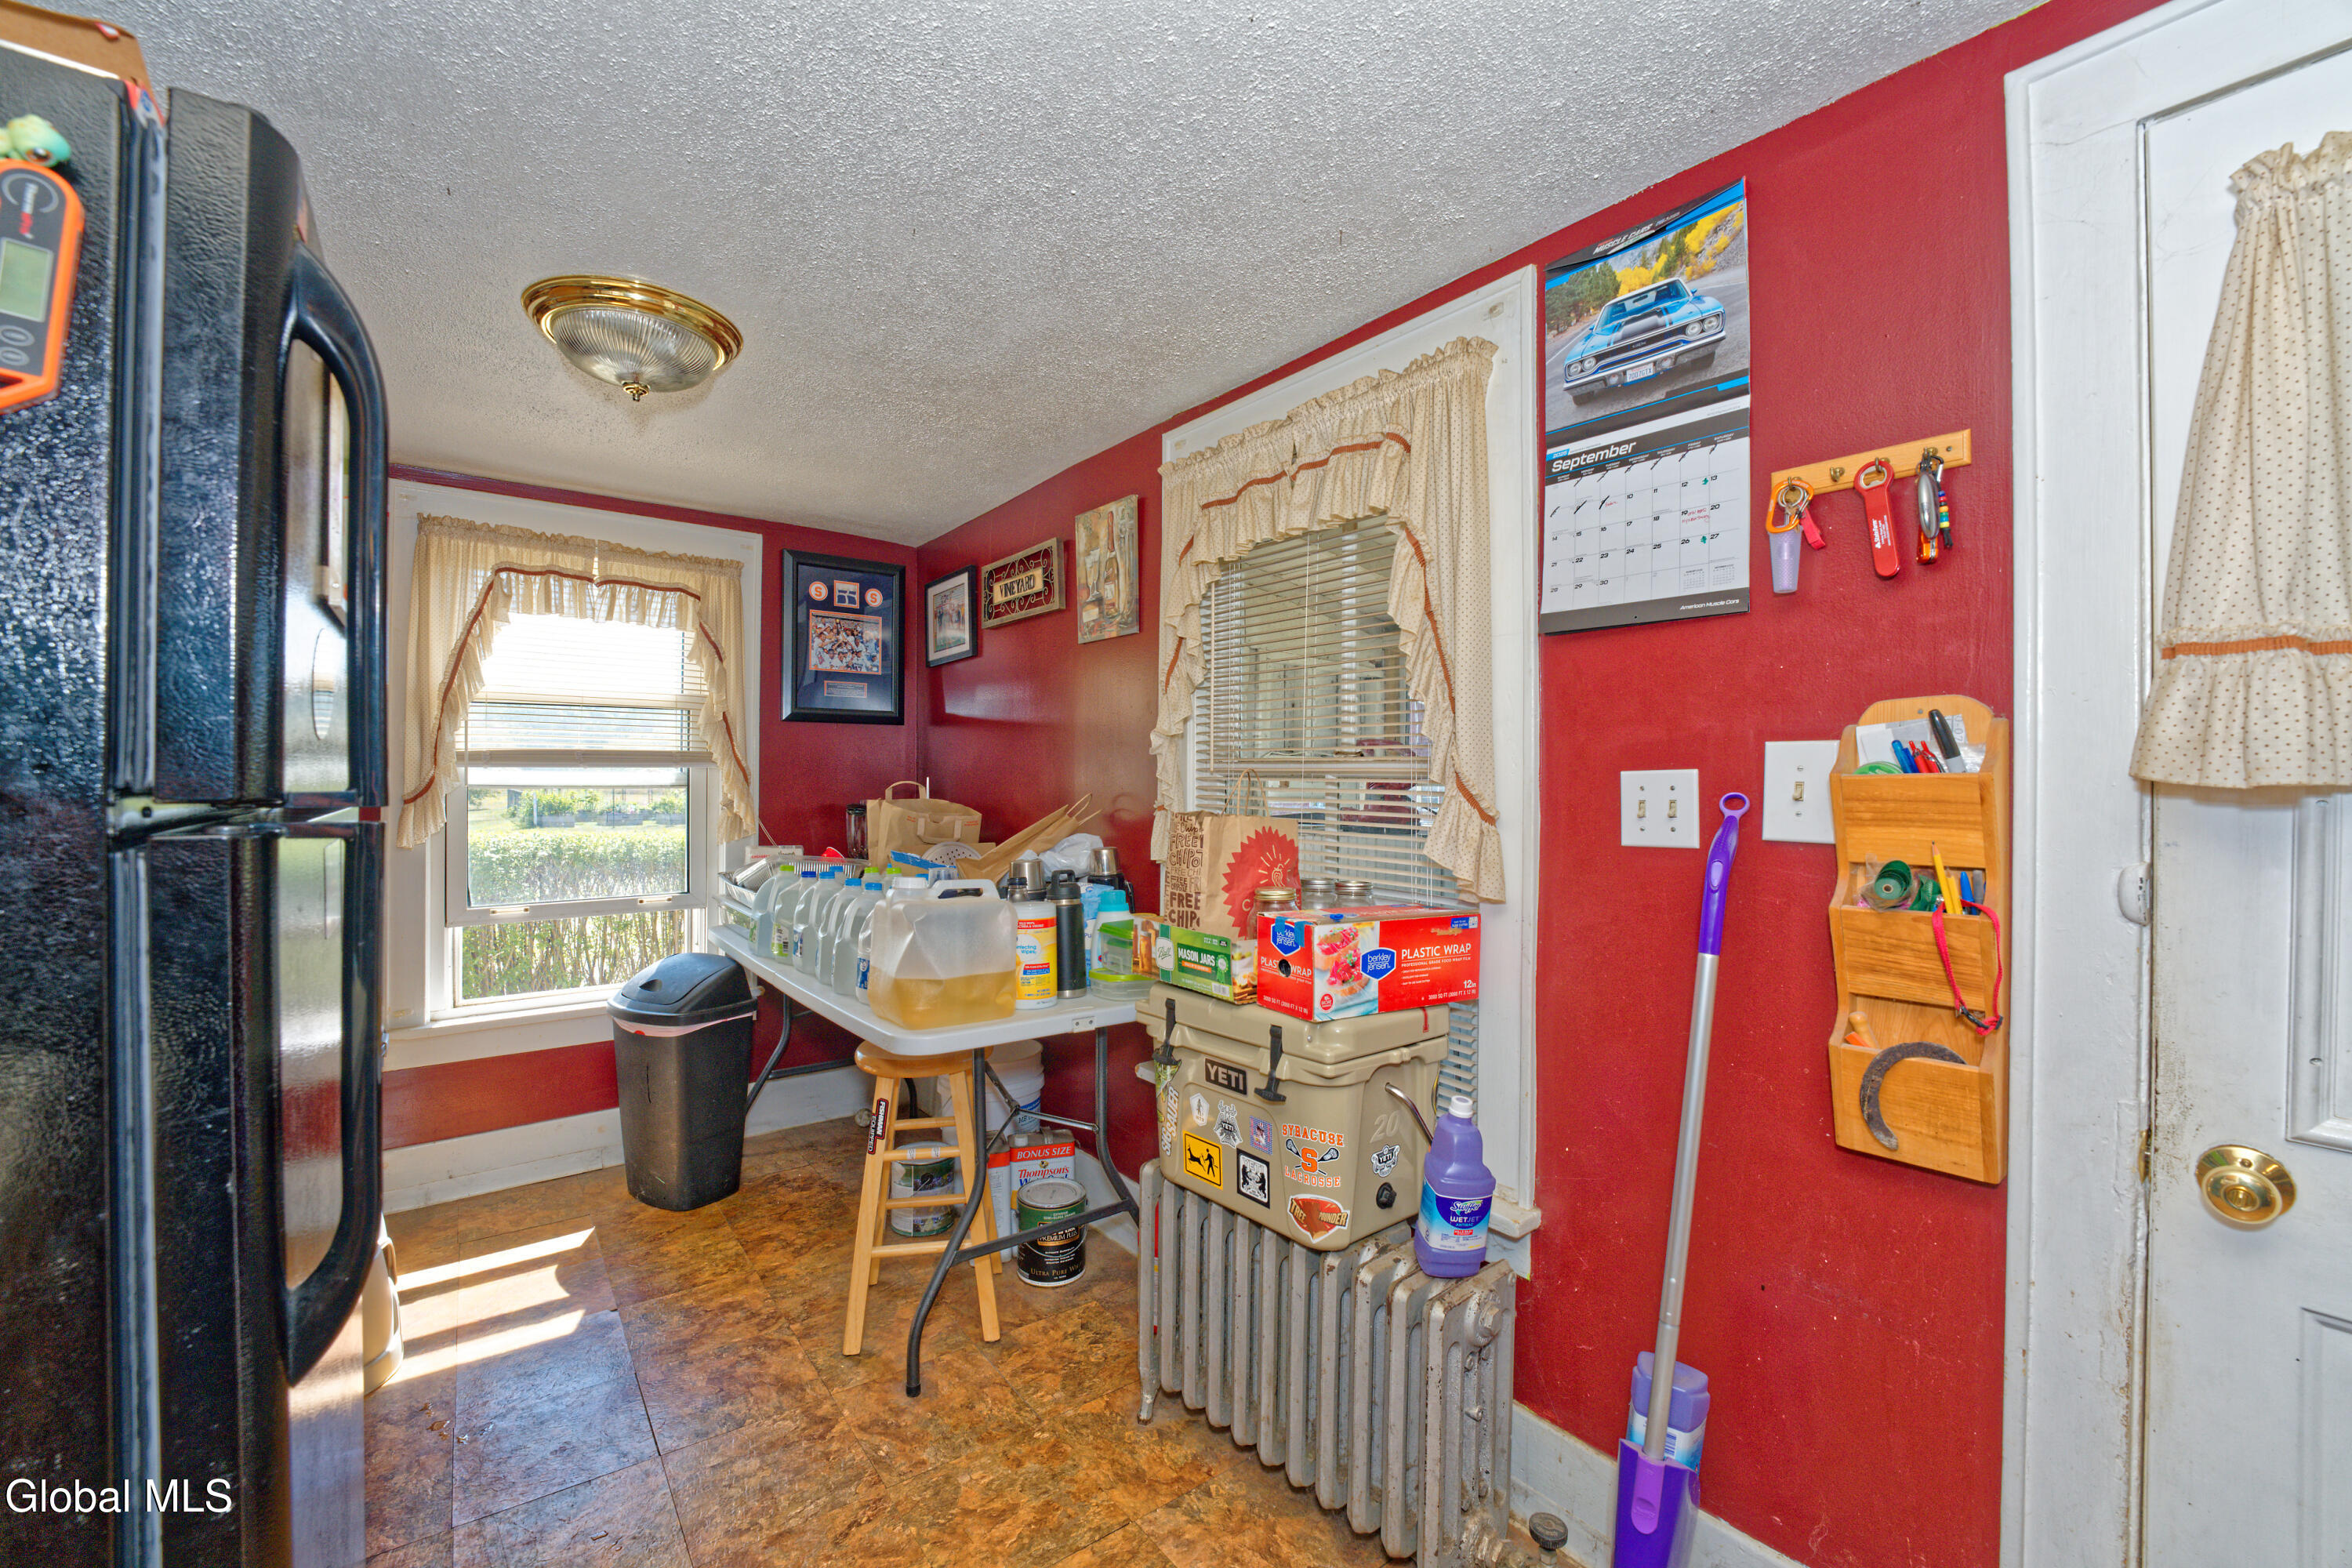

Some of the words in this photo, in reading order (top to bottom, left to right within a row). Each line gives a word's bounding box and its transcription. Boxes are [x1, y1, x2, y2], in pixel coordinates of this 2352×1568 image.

[1552, 441, 1636, 472] September
[815, 586, 823, 597] S
[1000, 574, 1035, 598] VINEYARD
[869, 593, 878, 604] S
[1170, 833, 1198, 851] FREE
[1170, 891, 1201, 910] FREE
[1158, 946, 1172, 960] Ball
[1178, 947, 1199, 963] MASON
[1200, 953, 1216, 967] JARS
[1367, 953, 1391, 963] berkley
[1401, 946, 1441, 960] PLASTIC
[1443, 942, 1472, 954] WRAP
[1367, 962, 1389, 973] jensen
[1206, 1062, 1244, 1094] YETI
[877, 1101, 886, 1135] FISHMAN
[1161, 1127, 1171, 1156] SIG
[1166, 1086, 1179, 1138] SAUER
[1222, 1122, 1234, 1131] YETI
[1370, 1110, 1399, 1143] 20
[868, 1115, 877, 1152] EQUIPPED
[1282, 1123, 1343, 1147] SYRACUSE
[1017, 1147, 1051, 1160] BONUS
[1051, 1145, 1072, 1156] SIZE
[1301, 1147, 1318, 1173] S
[1379, 1152, 1392, 1163] YETI
[1018, 1164, 1069, 1179] Thompson's
[1285, 1166, 1340, 1187] LACROSSE
[1290, 1199, 1306, 1224] TREE
[1450, 1201, 1482, 1214] Swiffer
[1319, 1211, 1348, 1226] POUNDER
[1030, 1268, 1050, 1276] ULTRA
